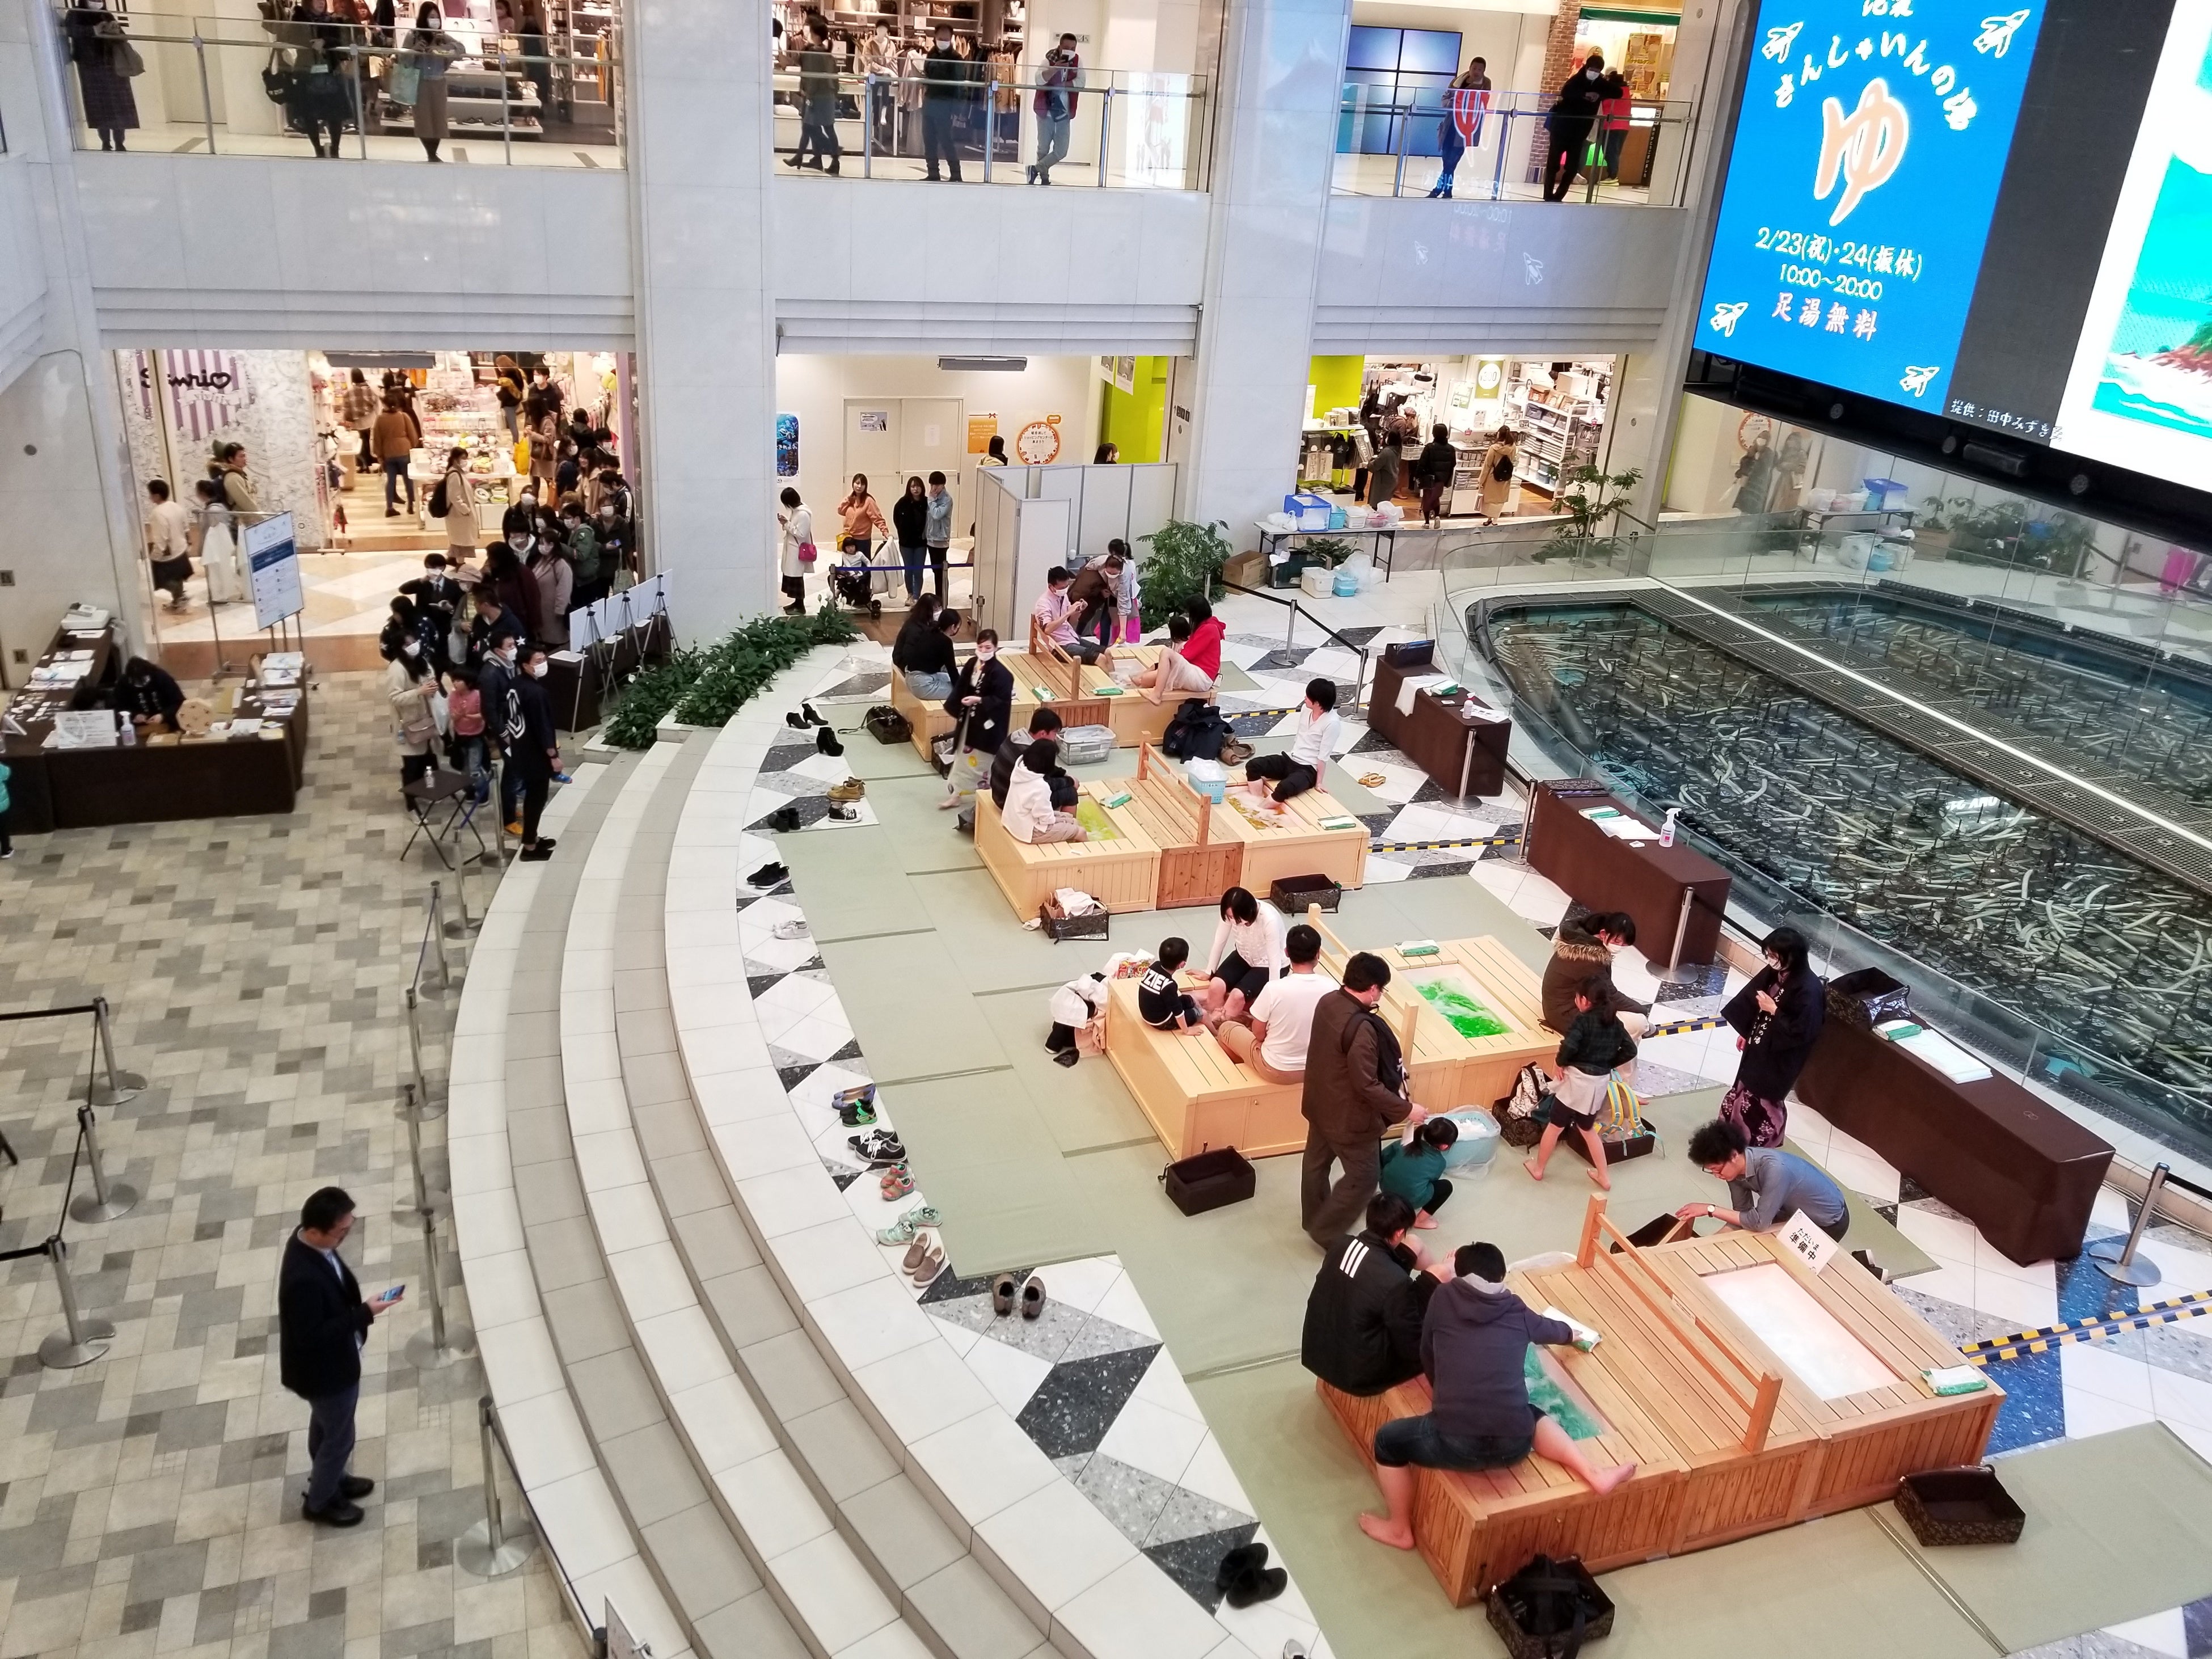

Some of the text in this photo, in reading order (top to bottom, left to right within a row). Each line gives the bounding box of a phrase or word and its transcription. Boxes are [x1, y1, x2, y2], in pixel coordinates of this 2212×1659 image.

[1813, 77, 1909, 226] ゆ
[1771, 291, 1878, 342] 足湯無料
[1789, 1232, 1817, 1260] 準備中
[1797, 1228, 1820, 1252] ただいま
